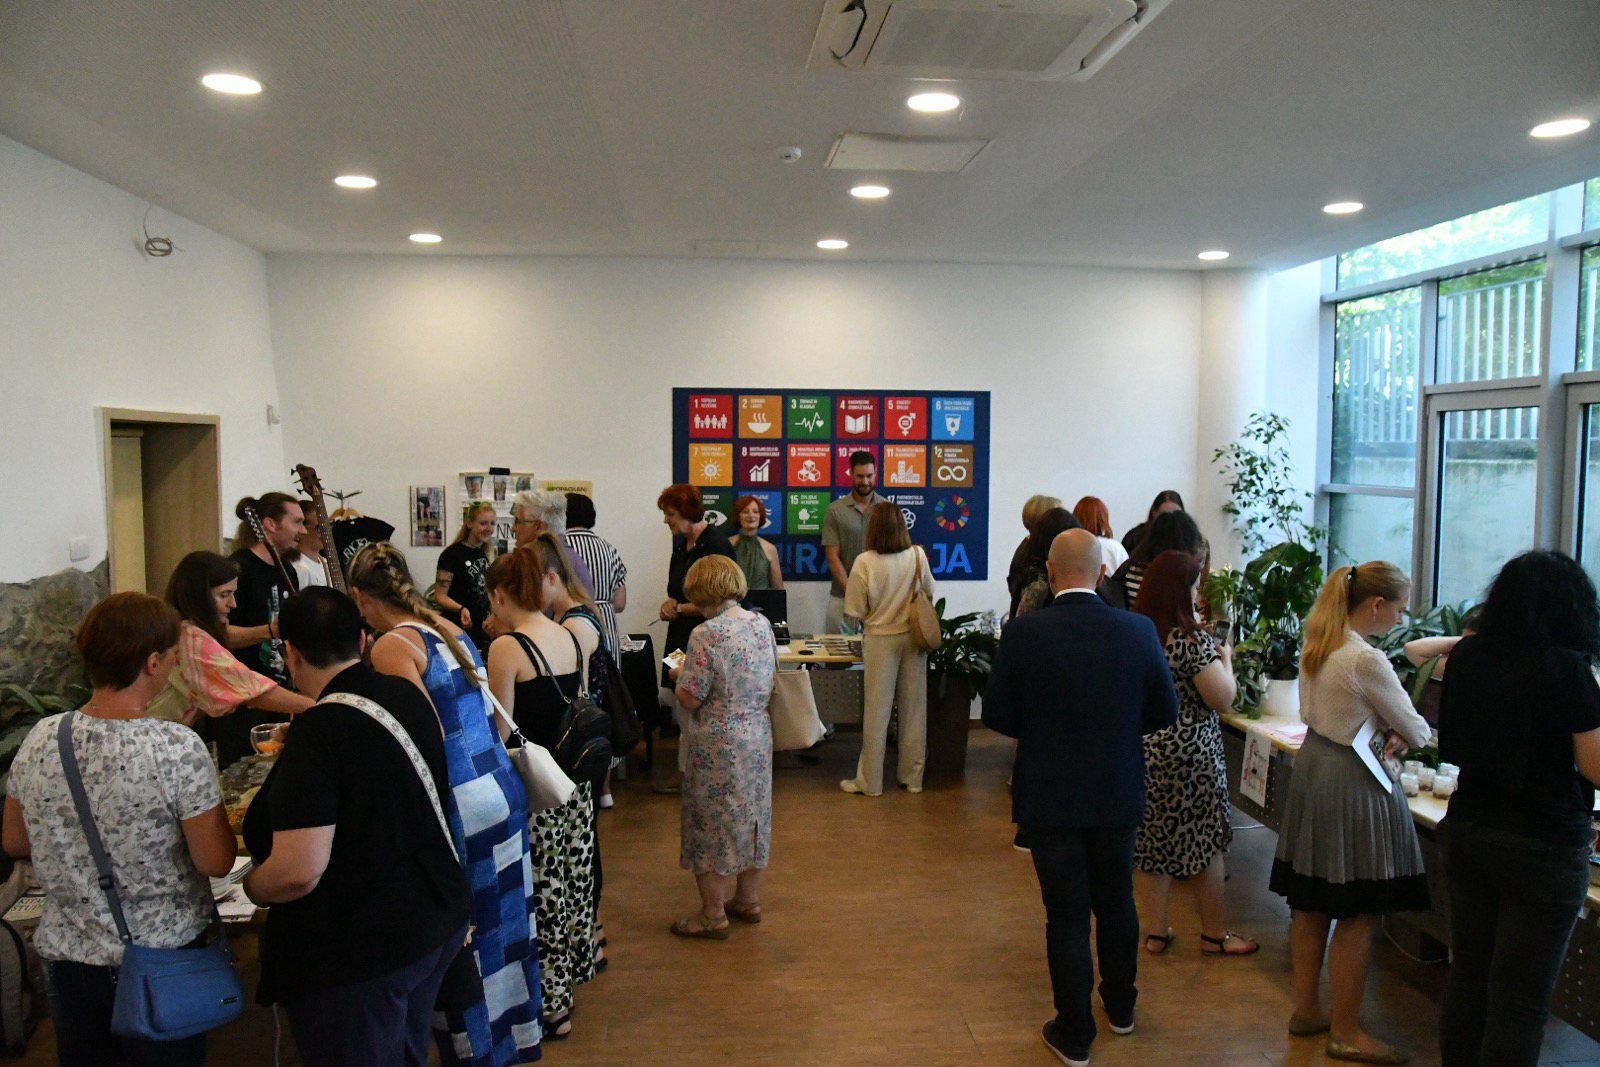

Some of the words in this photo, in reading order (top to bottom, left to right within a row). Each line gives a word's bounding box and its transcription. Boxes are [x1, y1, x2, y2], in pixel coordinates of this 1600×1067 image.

[694, 398, 699, 409] 1
[742, 398, 748, 409] 2
[791, 398, 797, 409] 3
[840, 399, 846, 410] 4
[888, 399, 894, 410] 5
[935, 400, 942, 411] 6
[694, 447, 699, 457] 7
[741, 446, 748, 457] 8
[790, 447, 797, 457] 9
[838, 447, 847, 457] 10
[886, 447, 894, 457] 11
[934, 445, 943, 458] 12
[790, 494, 799, 505] 15
[887, 495, 895, 504] 17
[932, 543, 973, 574] JA
